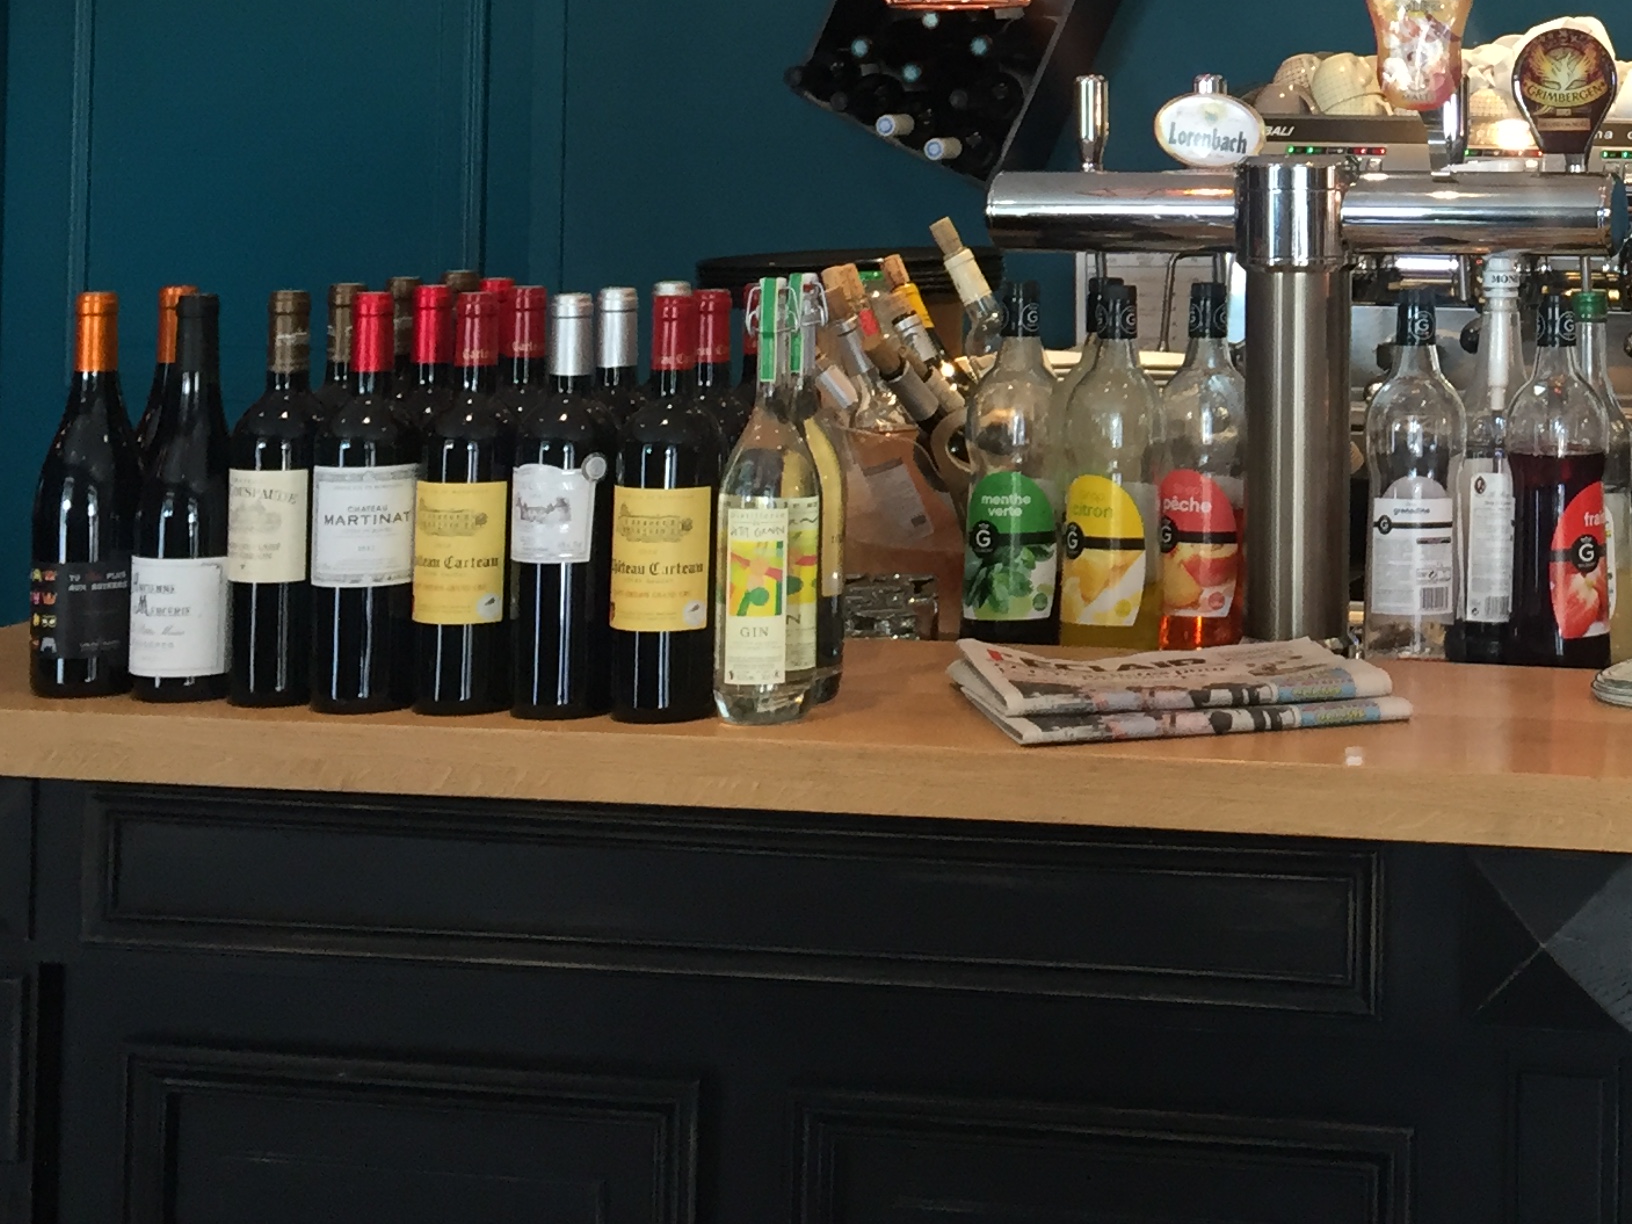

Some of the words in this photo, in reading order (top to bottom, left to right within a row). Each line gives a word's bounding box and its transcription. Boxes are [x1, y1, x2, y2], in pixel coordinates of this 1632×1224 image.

[1526, 83, 1603, 104] GRIMBERGEN
[1168, 121, 1248, 155] Lorenbach
[981, 493, 1032, 506] menthe
[1162, 495, 1212, 514] pêche
[324, 510, 411, 526] MARTINAT
[988, 506, 1023, 517] verte
[1072, 502, 1113, 519] citron
[976, 528, 992, 546] G
[1577, 543, 1596, 561] G
[739, 626, 770, 639] GIN
